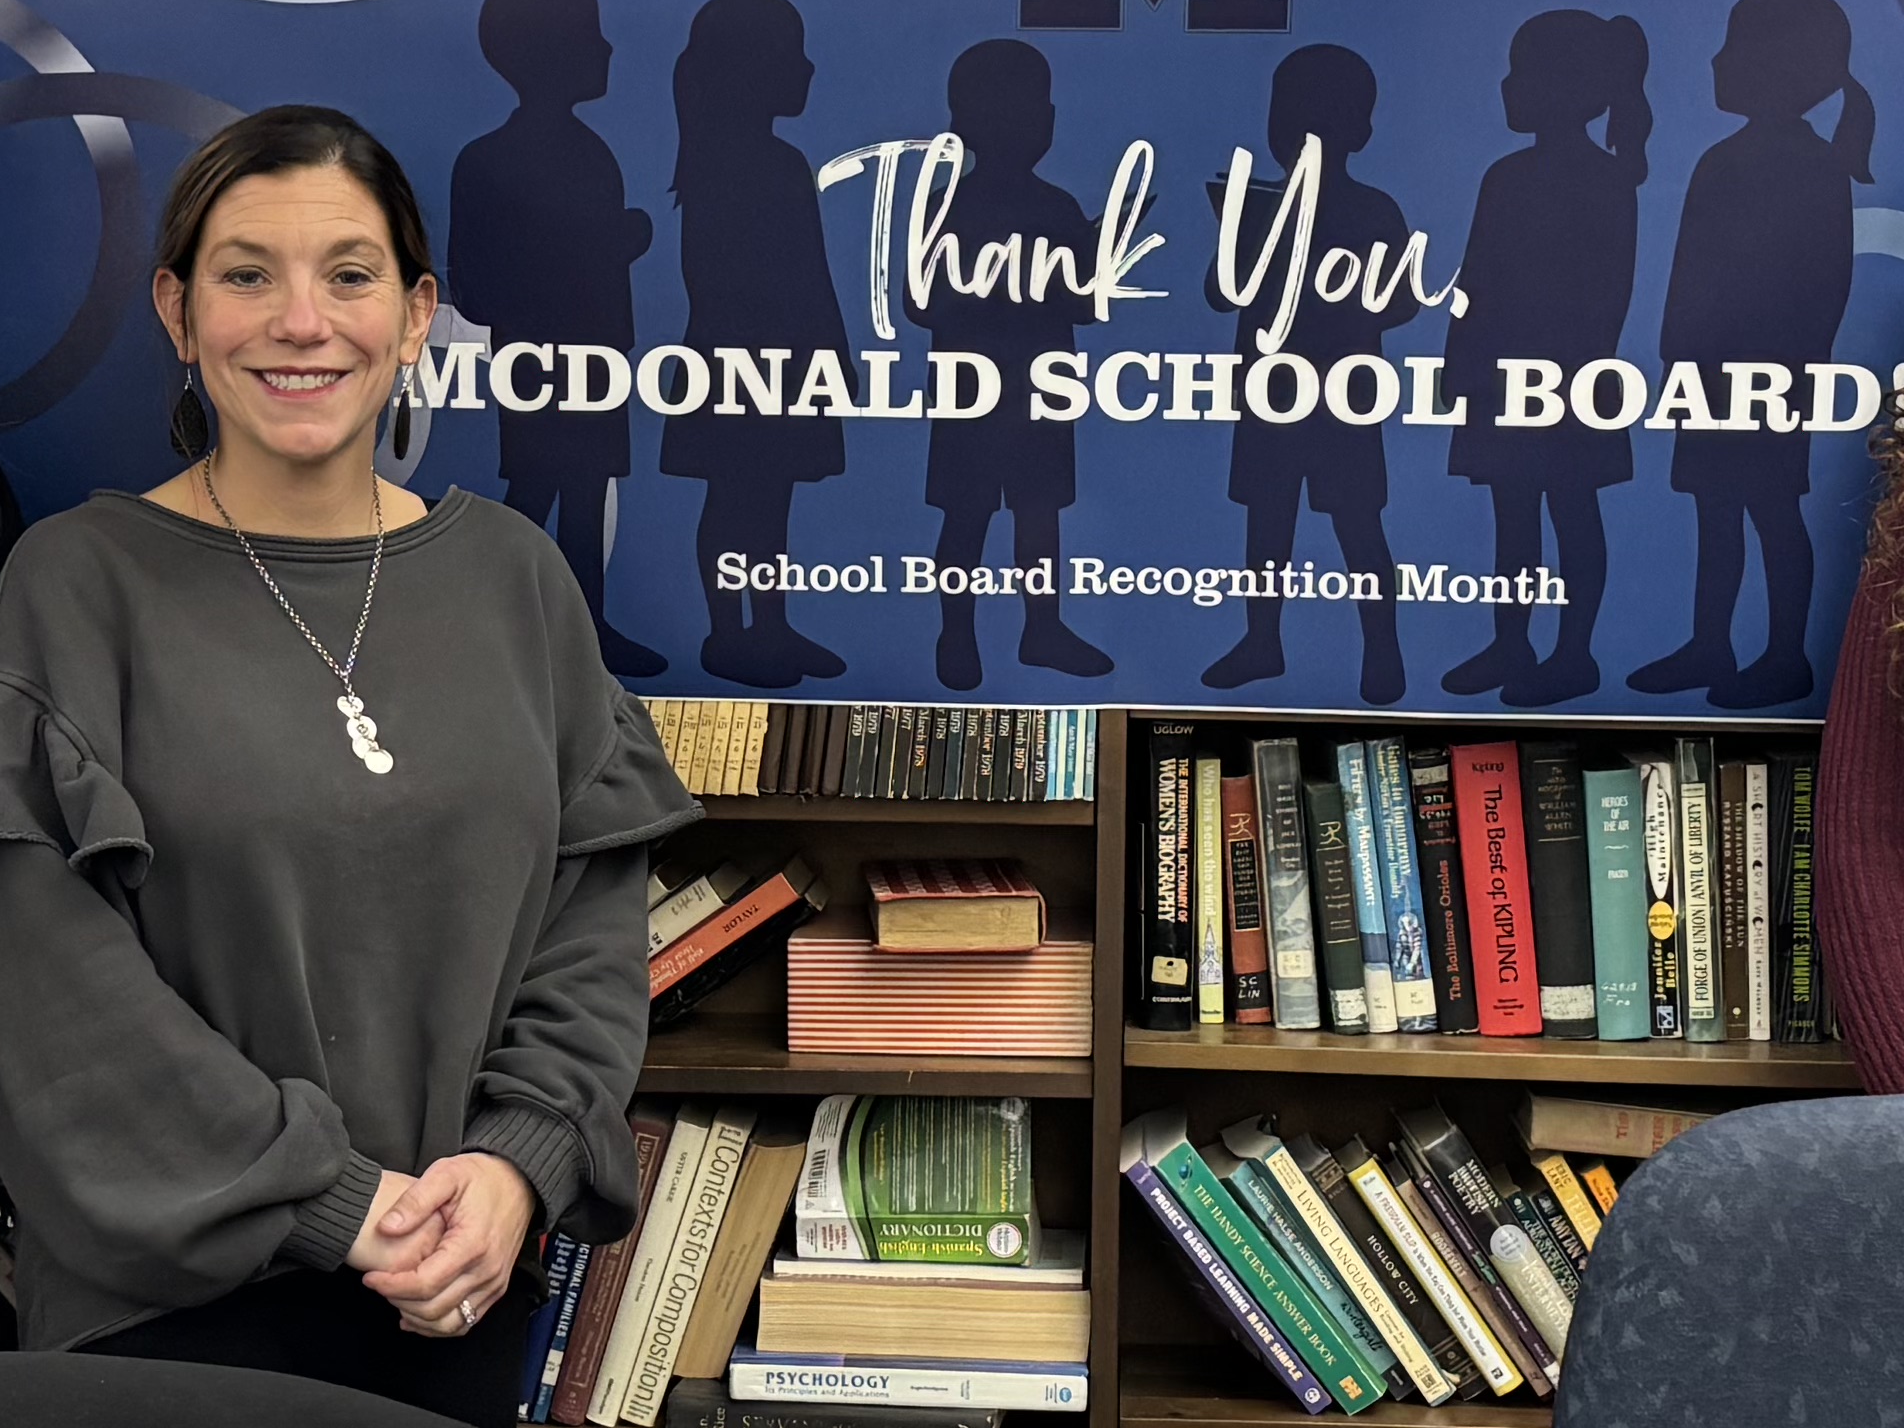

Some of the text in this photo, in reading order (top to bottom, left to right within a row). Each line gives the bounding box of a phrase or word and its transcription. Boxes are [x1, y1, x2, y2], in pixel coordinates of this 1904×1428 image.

[817, 132, 1470, 355] Thank You,
[393, 341, 1002, 422] MCDONALD
[1029, 351, 1469, 429] SCHOOL
[714, 552, 1571, 609] School Board Recognition Month
[1157, 758, 1176, 922] WOMEN'S BIOGRAPHY
[1483, 784, 1519, 985] The Best of KIPLING
[1687, 800, 1709, 1002] FORGE OF UNION ANVIL OF LIBERTY
[721, 904, 761, 935] TAYLOR
[1440, 860, 1460, 1000] The Baltimore Orioles
[1792, 873, 1811, 1003] CHARLOTTE SIMMONS
[636, 1145, 740, 1398] Contexts for Composition
[879, 1223, 983, 1237] DICTIONARY
[1150, 1187, 1302, 1382] PROJECT BASED LEARNING MADE SIMPLE
[1194, 1184, 1337, 1367] THE HANDY SCIENCE ANSWER BOOK
[1248, 1180, 1333, 1291] LAURIE HALSE ANDERSON
[1297, 1189, 1383, 1313] LIVING LANGUAGES
[1367, 1235, 1420, 1306] HOLLOW CITY
[556, 1289, 576, 1338] FAMILIES
[765, 1371, 890, 1389] PSYCHOLOGY
